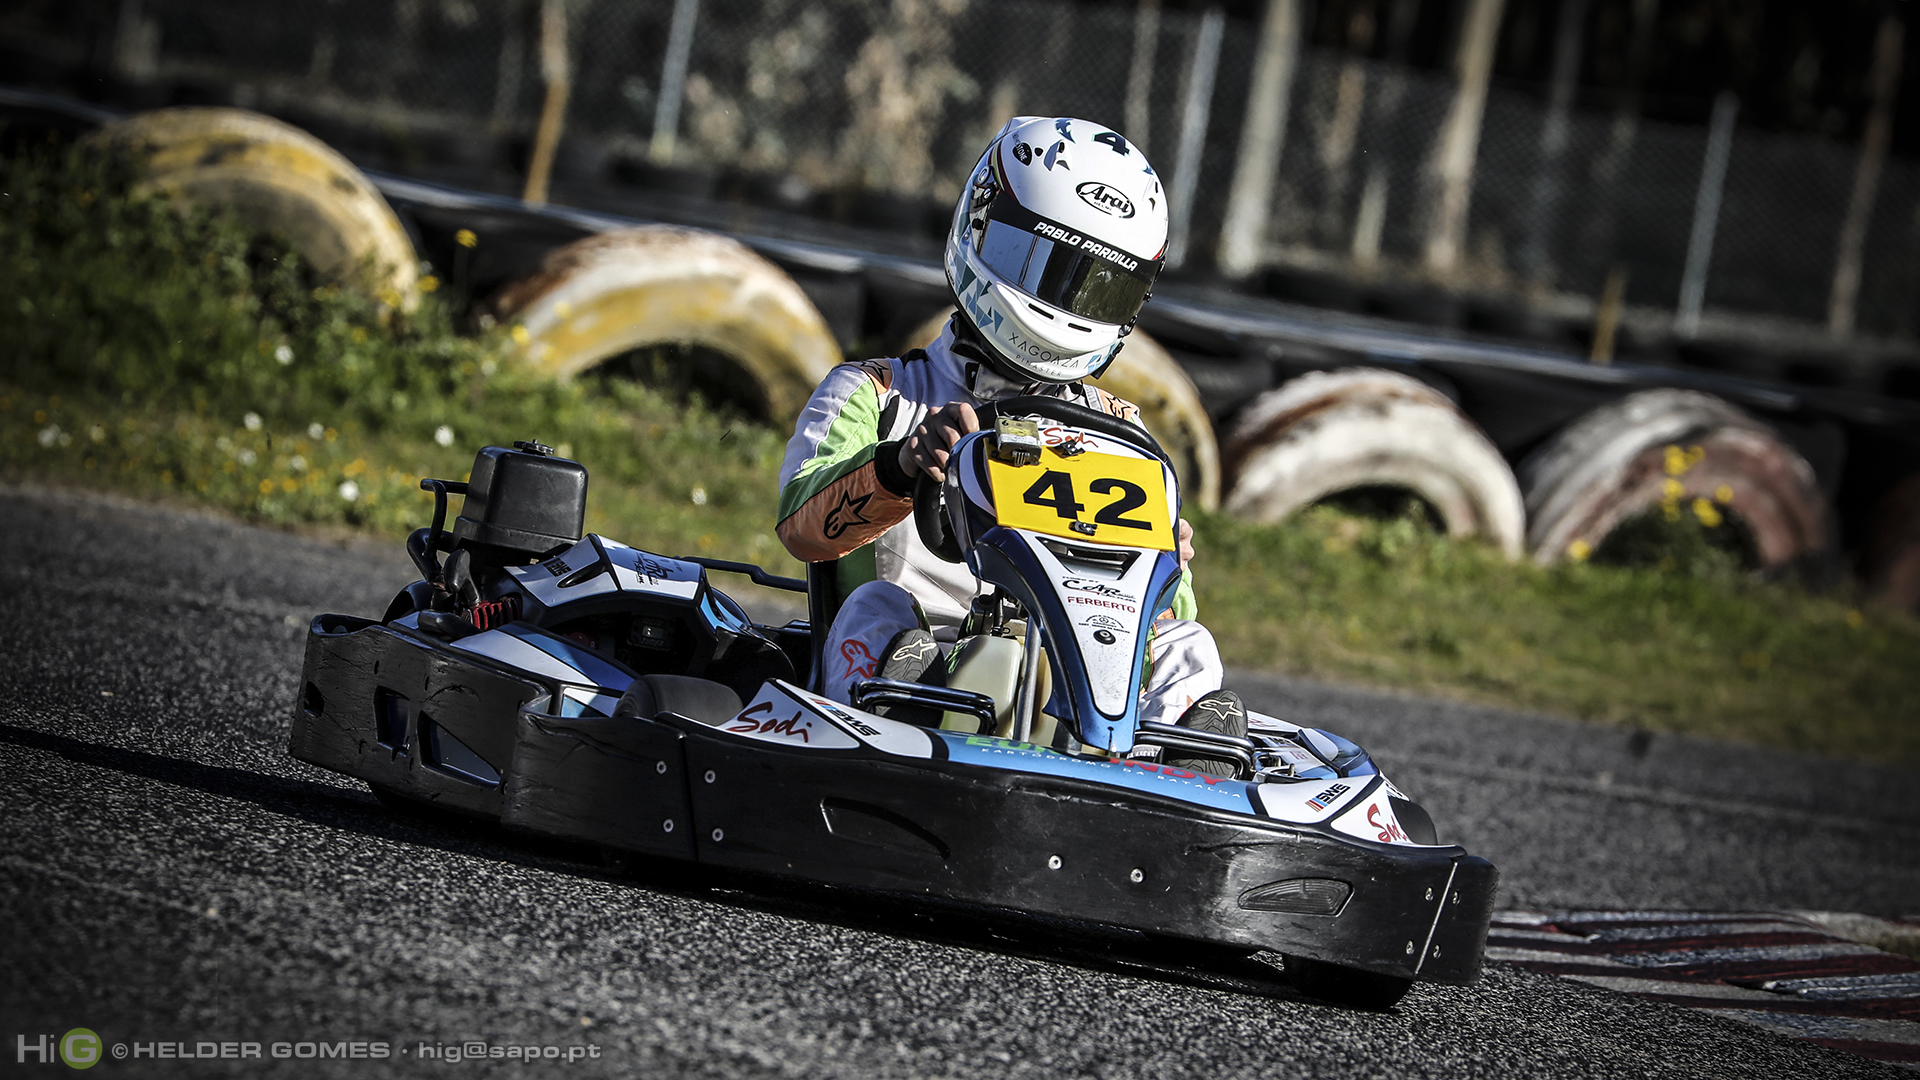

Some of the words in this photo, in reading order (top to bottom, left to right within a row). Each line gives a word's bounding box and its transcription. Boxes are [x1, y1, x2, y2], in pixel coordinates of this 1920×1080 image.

[1093, 132, 1130, 157] 4
[1080, 185, 1130, 213] Arai
[1033, 221, 1082, 247] PABLO
[1080, 239, 1139, 272] PARDILLA
[1008, 332, 1079, 368] XAGOAZA
[1015, 354, 1063, 377] PINASTER
[1023, 470, 1153, 531] 42
[1067, 596, 1136, 614] FERBERTO
[726, 701, 812, 743] Sodi
[827, 708, 882, 737] SWS
[1123, 767, 1144, 776] DA
[1157, 775, 1240, 798] BATALHA
[1316, 783, 1351, 803] SWS
